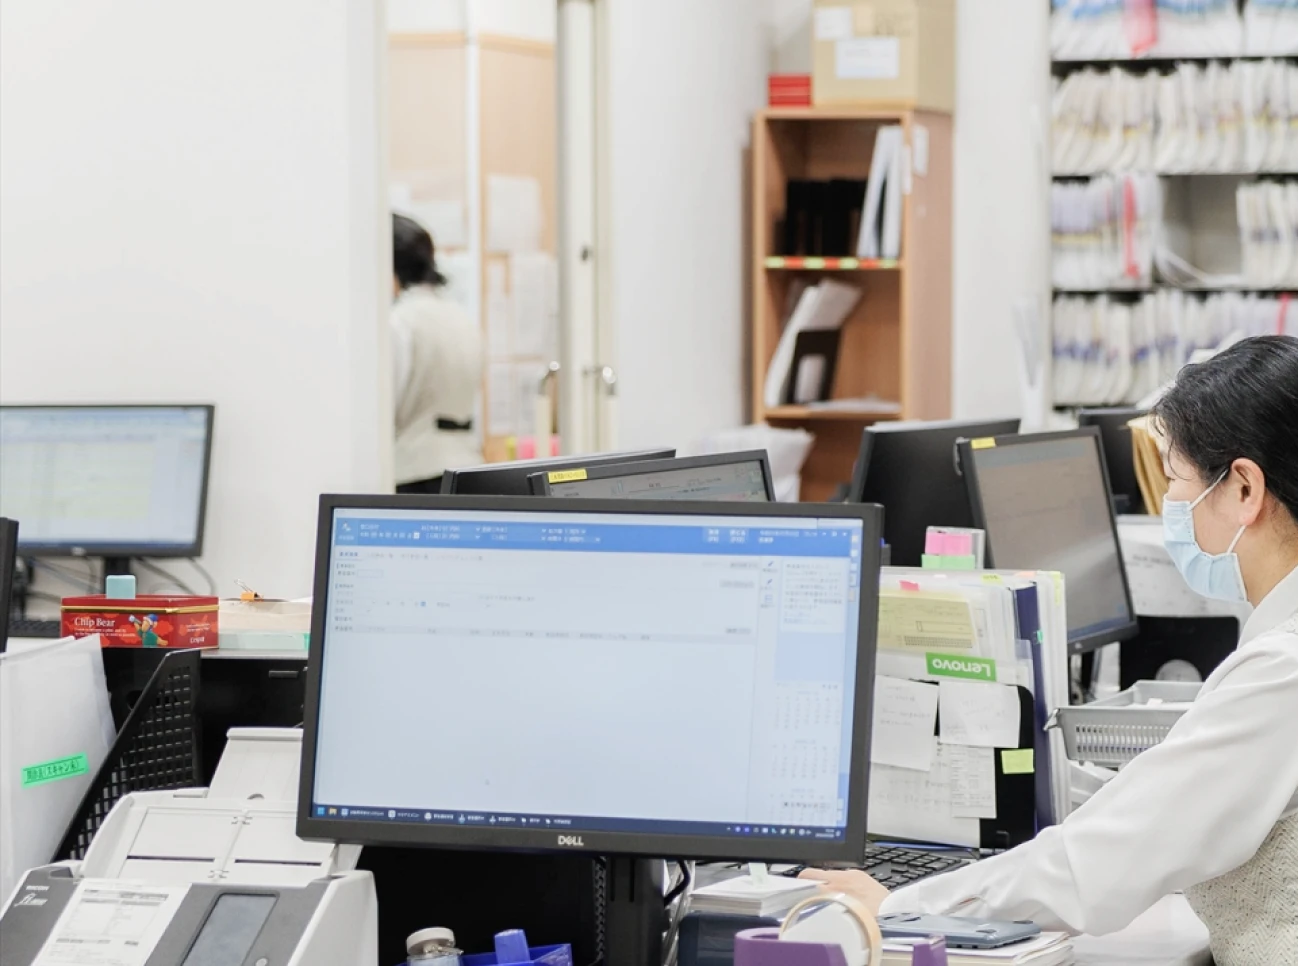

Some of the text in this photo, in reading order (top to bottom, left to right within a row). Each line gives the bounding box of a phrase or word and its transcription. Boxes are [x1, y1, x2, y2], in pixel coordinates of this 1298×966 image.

[74, 617, 115, 628] Chip Bear
[933, 659, 990, 677] Lenovo
[558, 835, 584, 846] DELL
